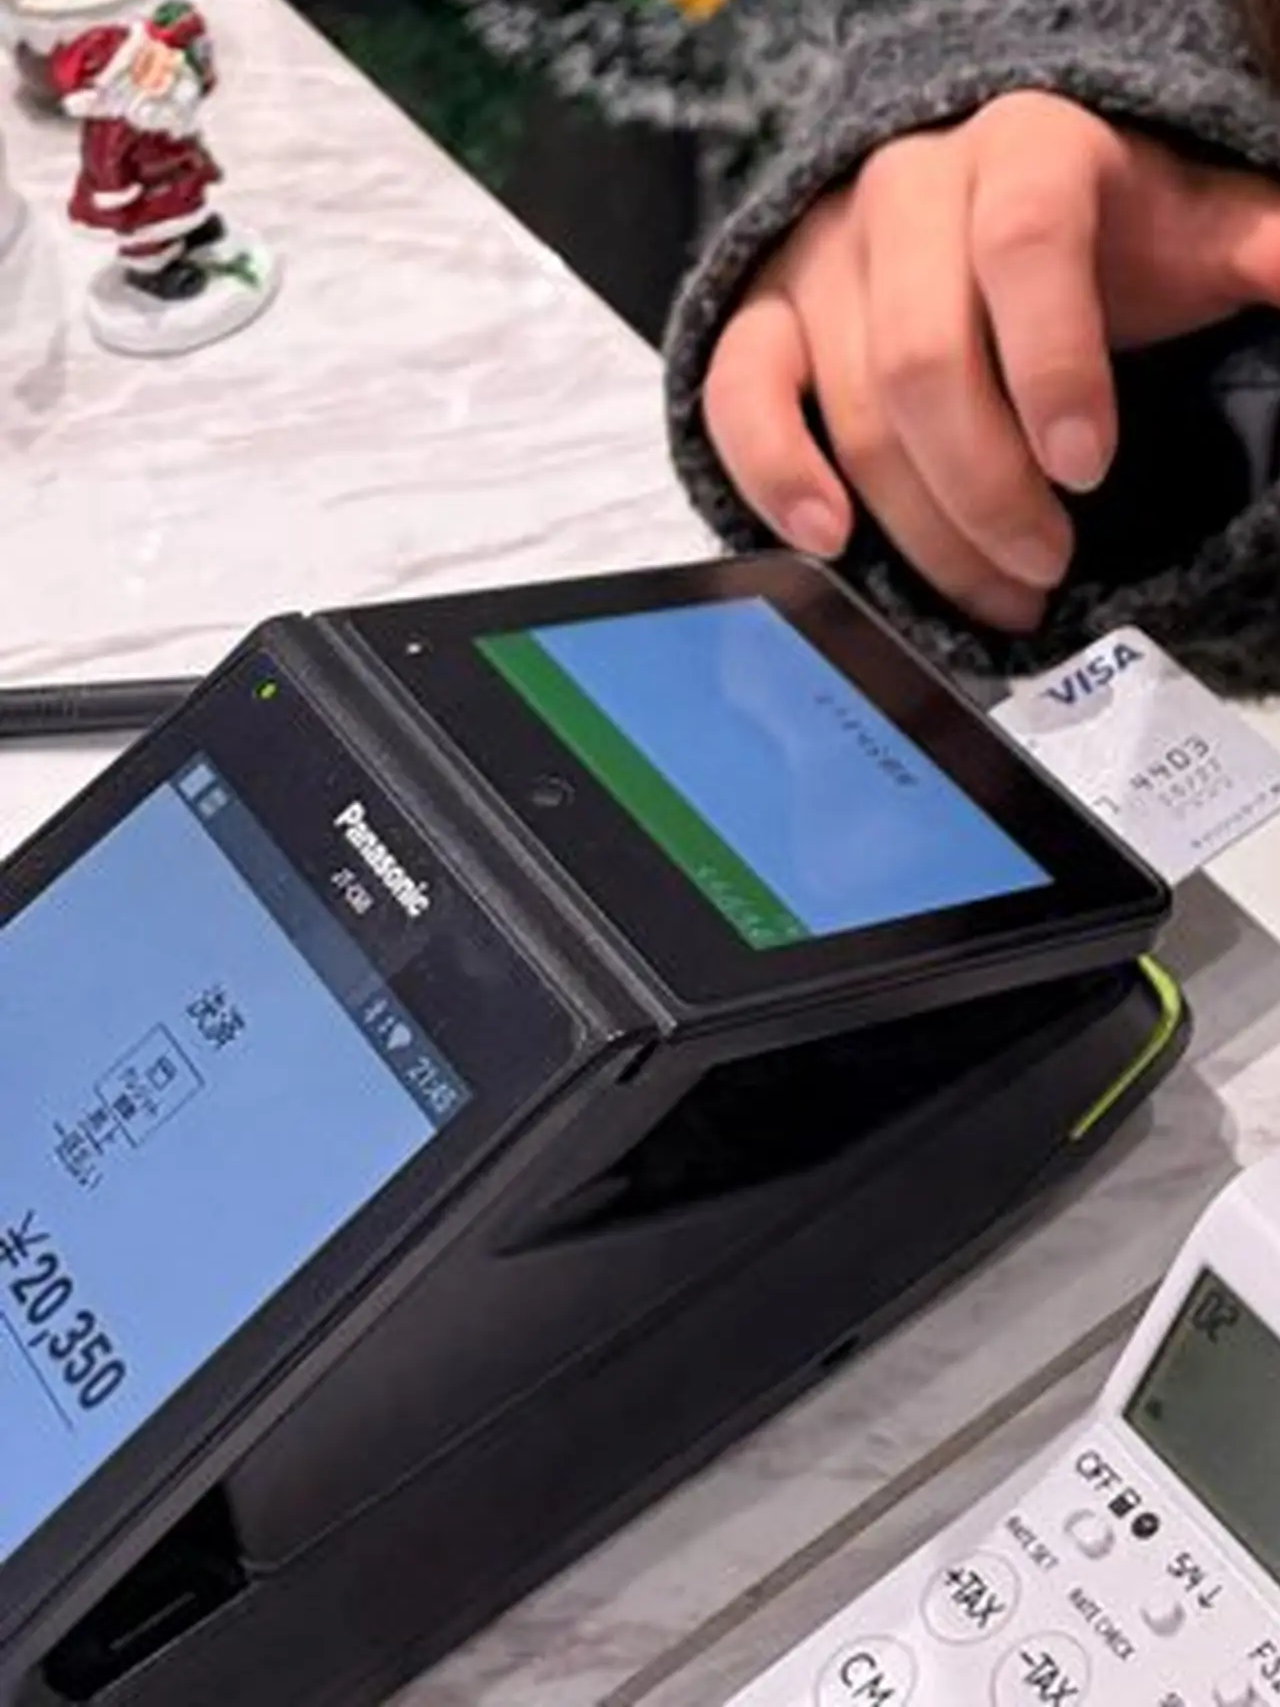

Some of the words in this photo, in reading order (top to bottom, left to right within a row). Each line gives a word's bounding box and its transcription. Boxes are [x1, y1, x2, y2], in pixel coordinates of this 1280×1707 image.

[1044, 642, 1144, 706] VISA
[333, 800, 430, 918] Panasonic
[0, 1208, 126, 1411] ¥20,350
[1074, 1449, 1123, 1492] OFF
[943, 1565, 1005, 1629] +TAX
